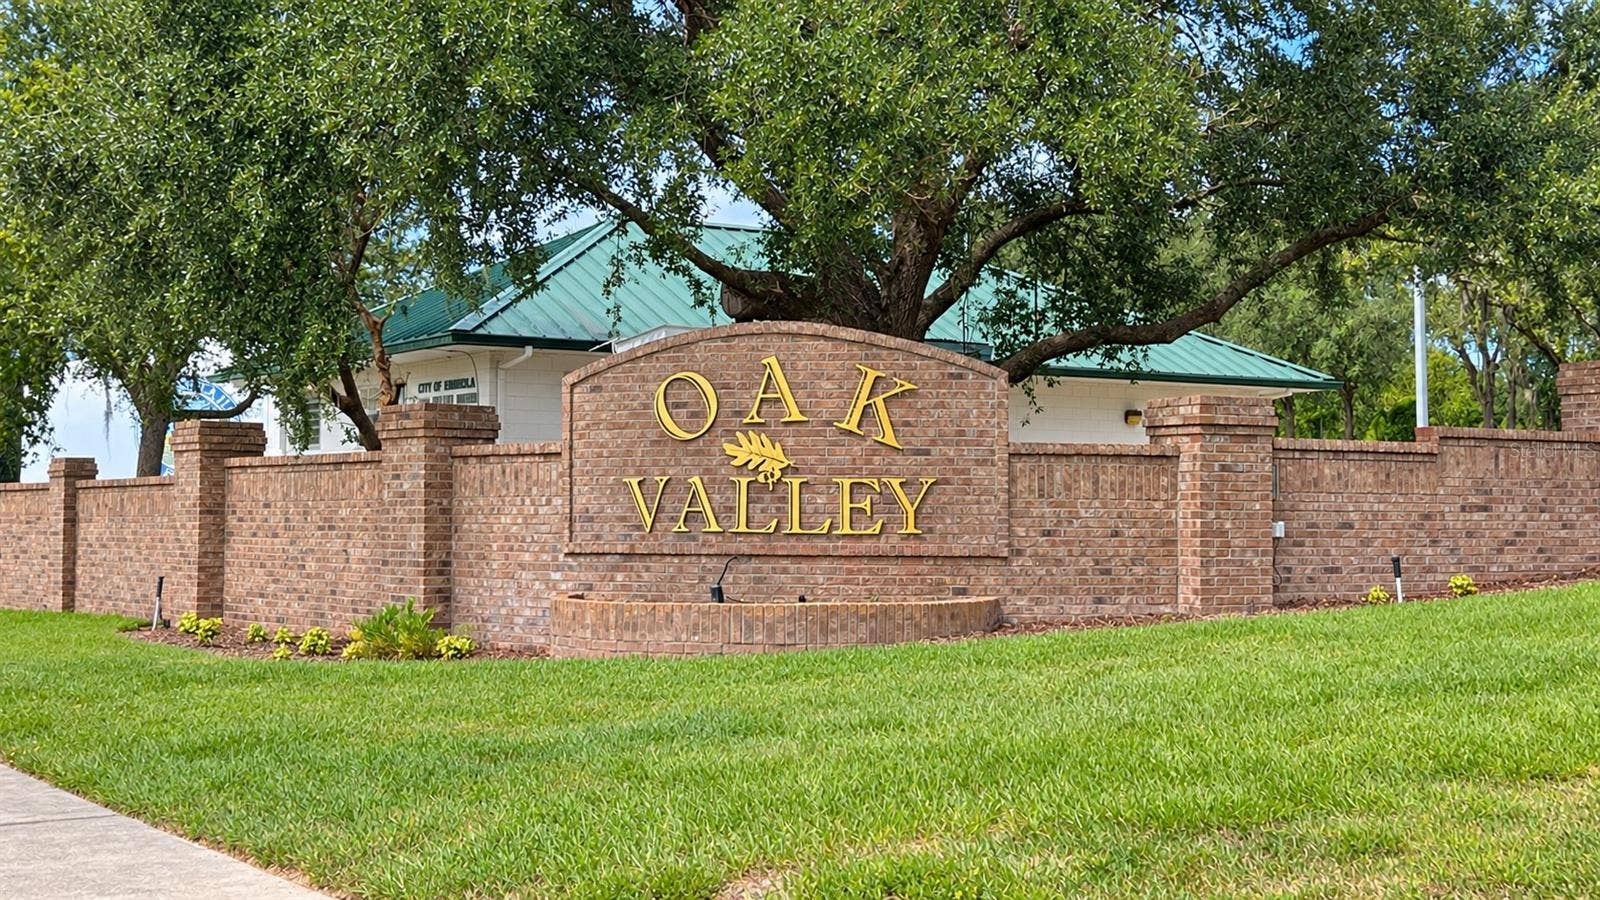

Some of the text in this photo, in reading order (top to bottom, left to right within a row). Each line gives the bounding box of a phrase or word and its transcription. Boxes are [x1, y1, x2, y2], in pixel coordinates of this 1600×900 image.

[418, 382, 433, 394] CITY
[433, 381, 442, 392] OF
[653, 355, 919, 449] OAK
[622, 476, 937, 535] VALLEY
